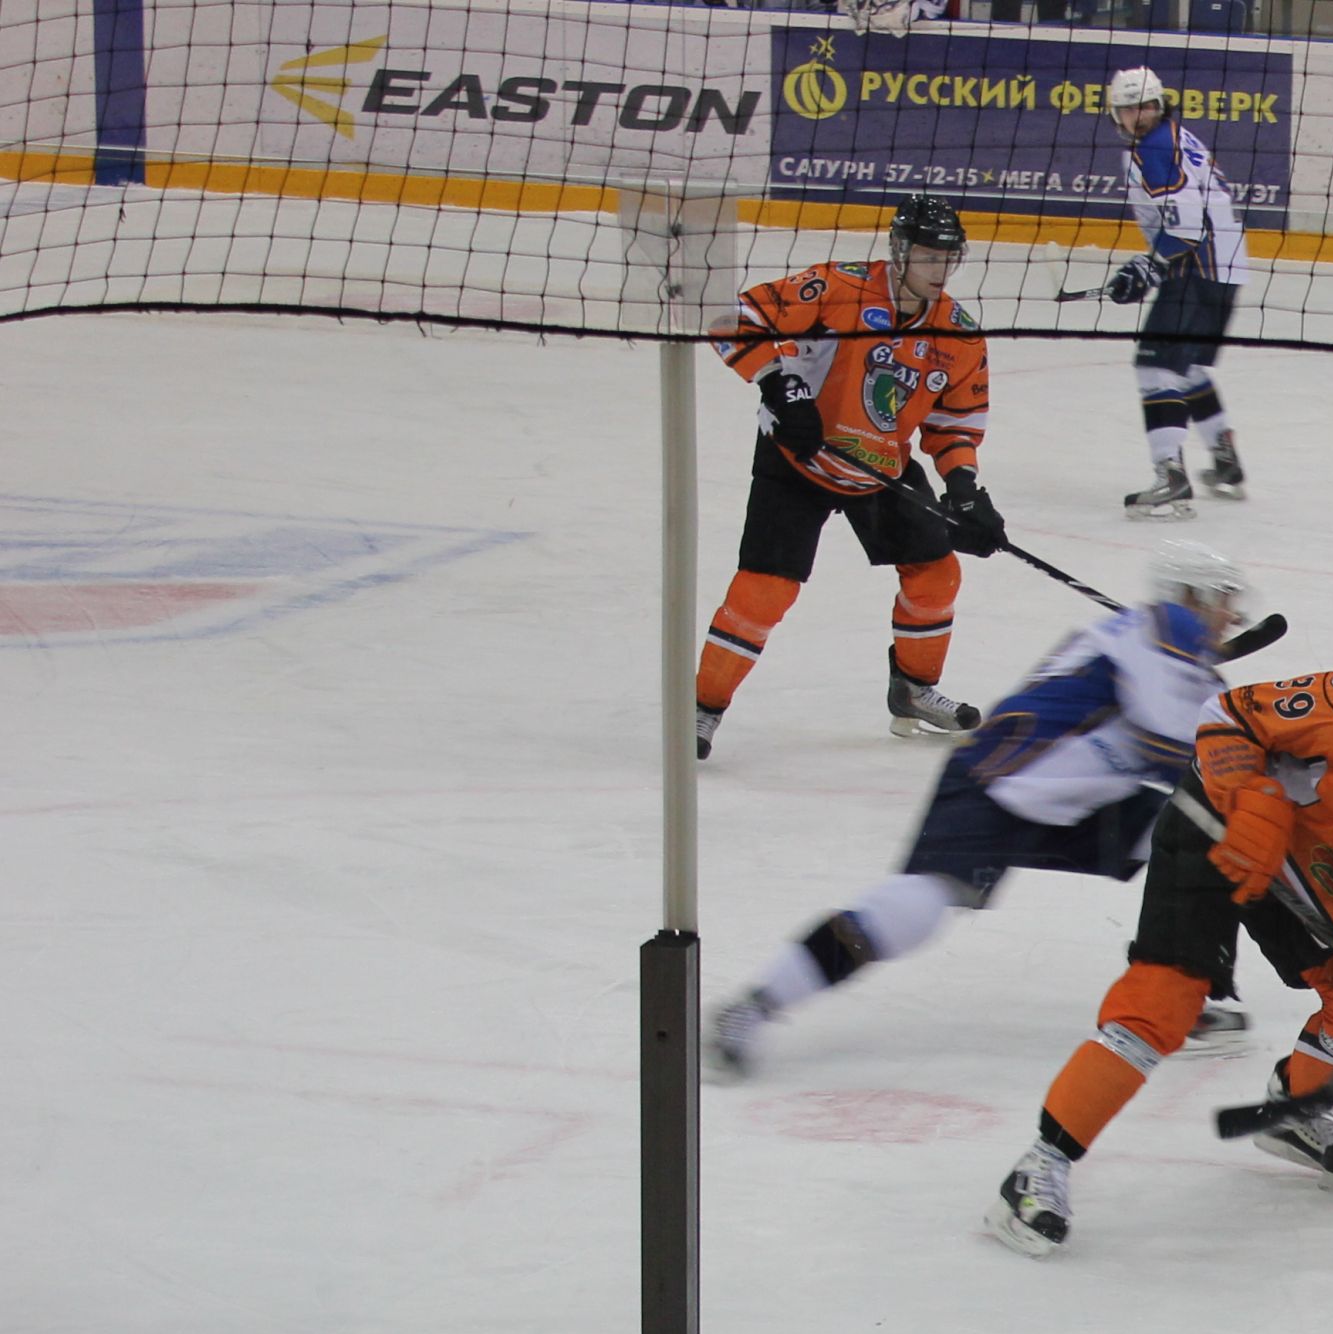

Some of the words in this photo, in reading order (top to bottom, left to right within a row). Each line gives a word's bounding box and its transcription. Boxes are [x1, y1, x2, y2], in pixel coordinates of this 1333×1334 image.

[361, 69, 762, 135] EASTON
[861, 71, 1036, 110] РУССКИЙ
[779, 157, 875, 181] САТУРН
